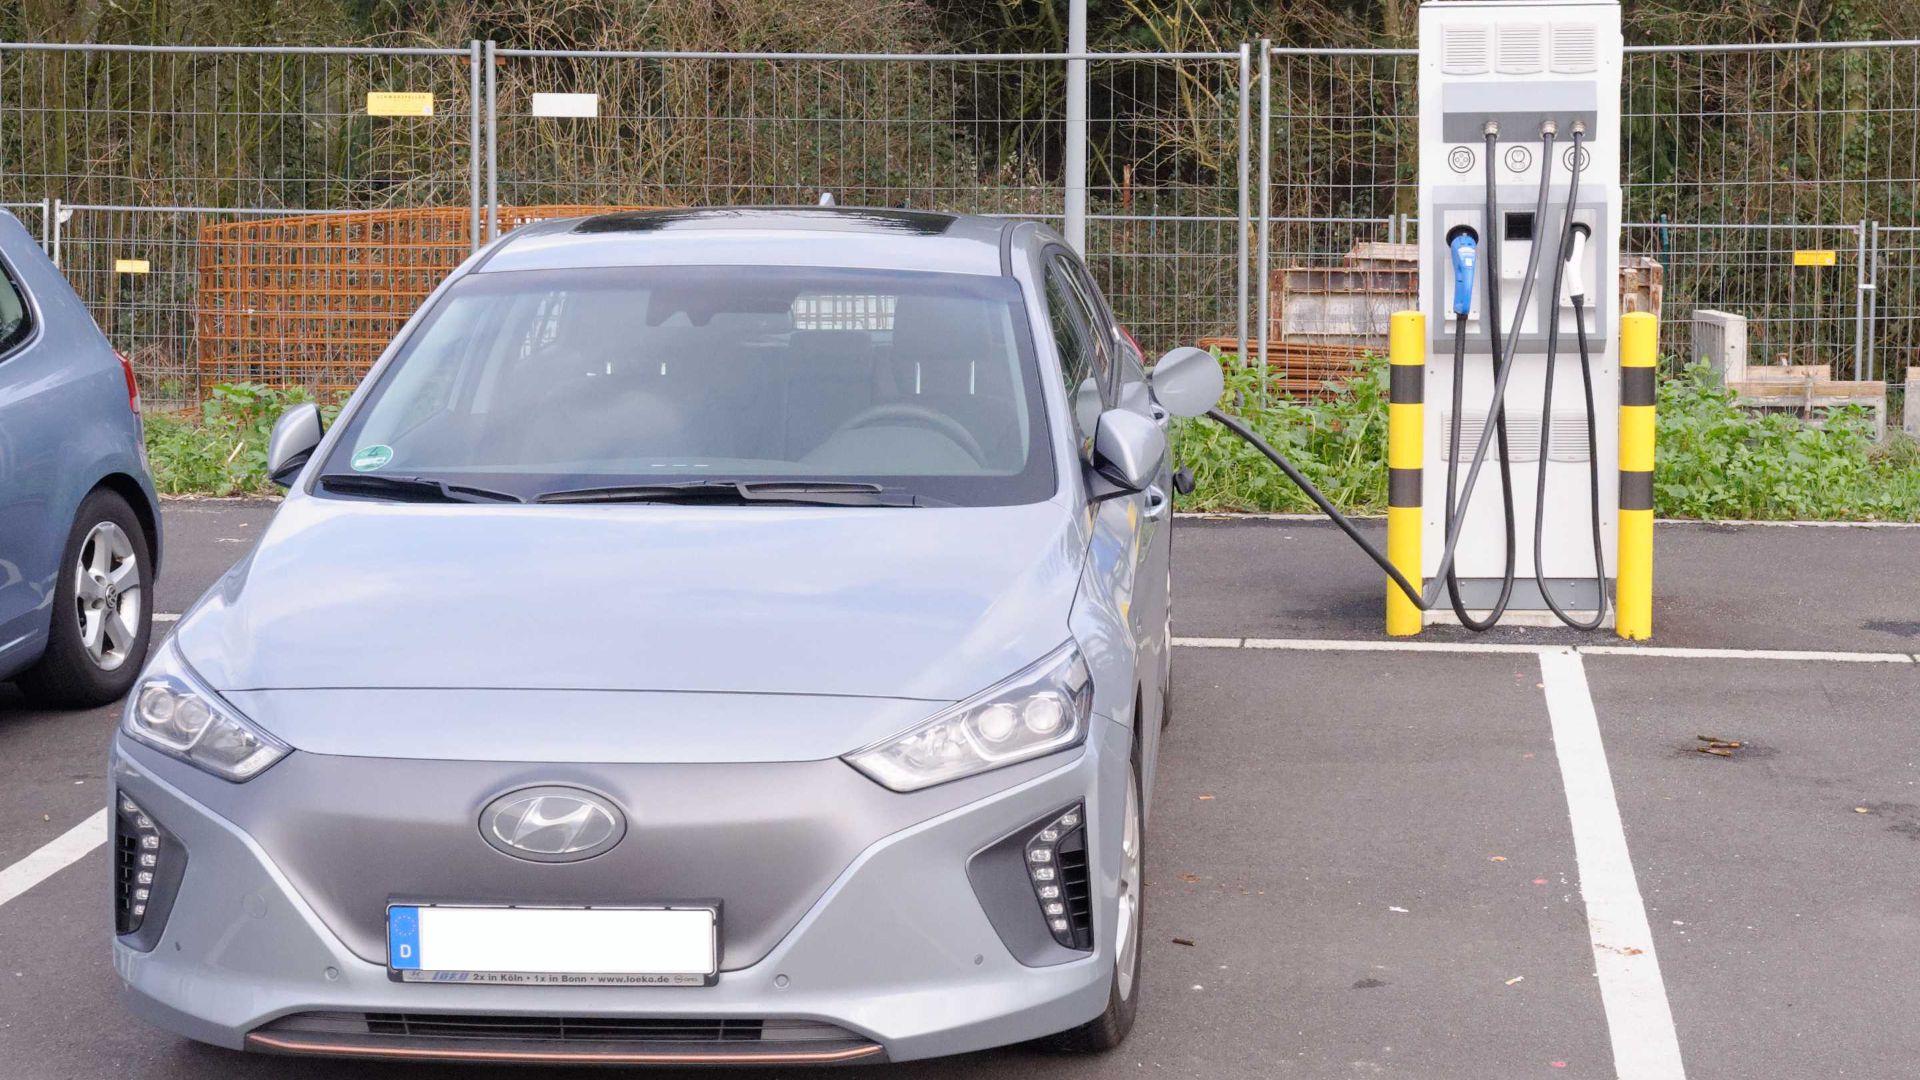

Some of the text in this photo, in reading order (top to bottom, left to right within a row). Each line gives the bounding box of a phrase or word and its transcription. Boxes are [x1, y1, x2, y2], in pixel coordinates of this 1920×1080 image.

[400, 944, 412, 958] D
[473, 973, 485, 982] 2x
[488, 973, 498, 982] in
[500, 973, 524, 983] Köln
[535, 975, 545, 983] 1x
[549, 975, 559, 983] in
[561, 975, 588, 984] Bonn
[598, 975, 670, 985] www.loeko.de
